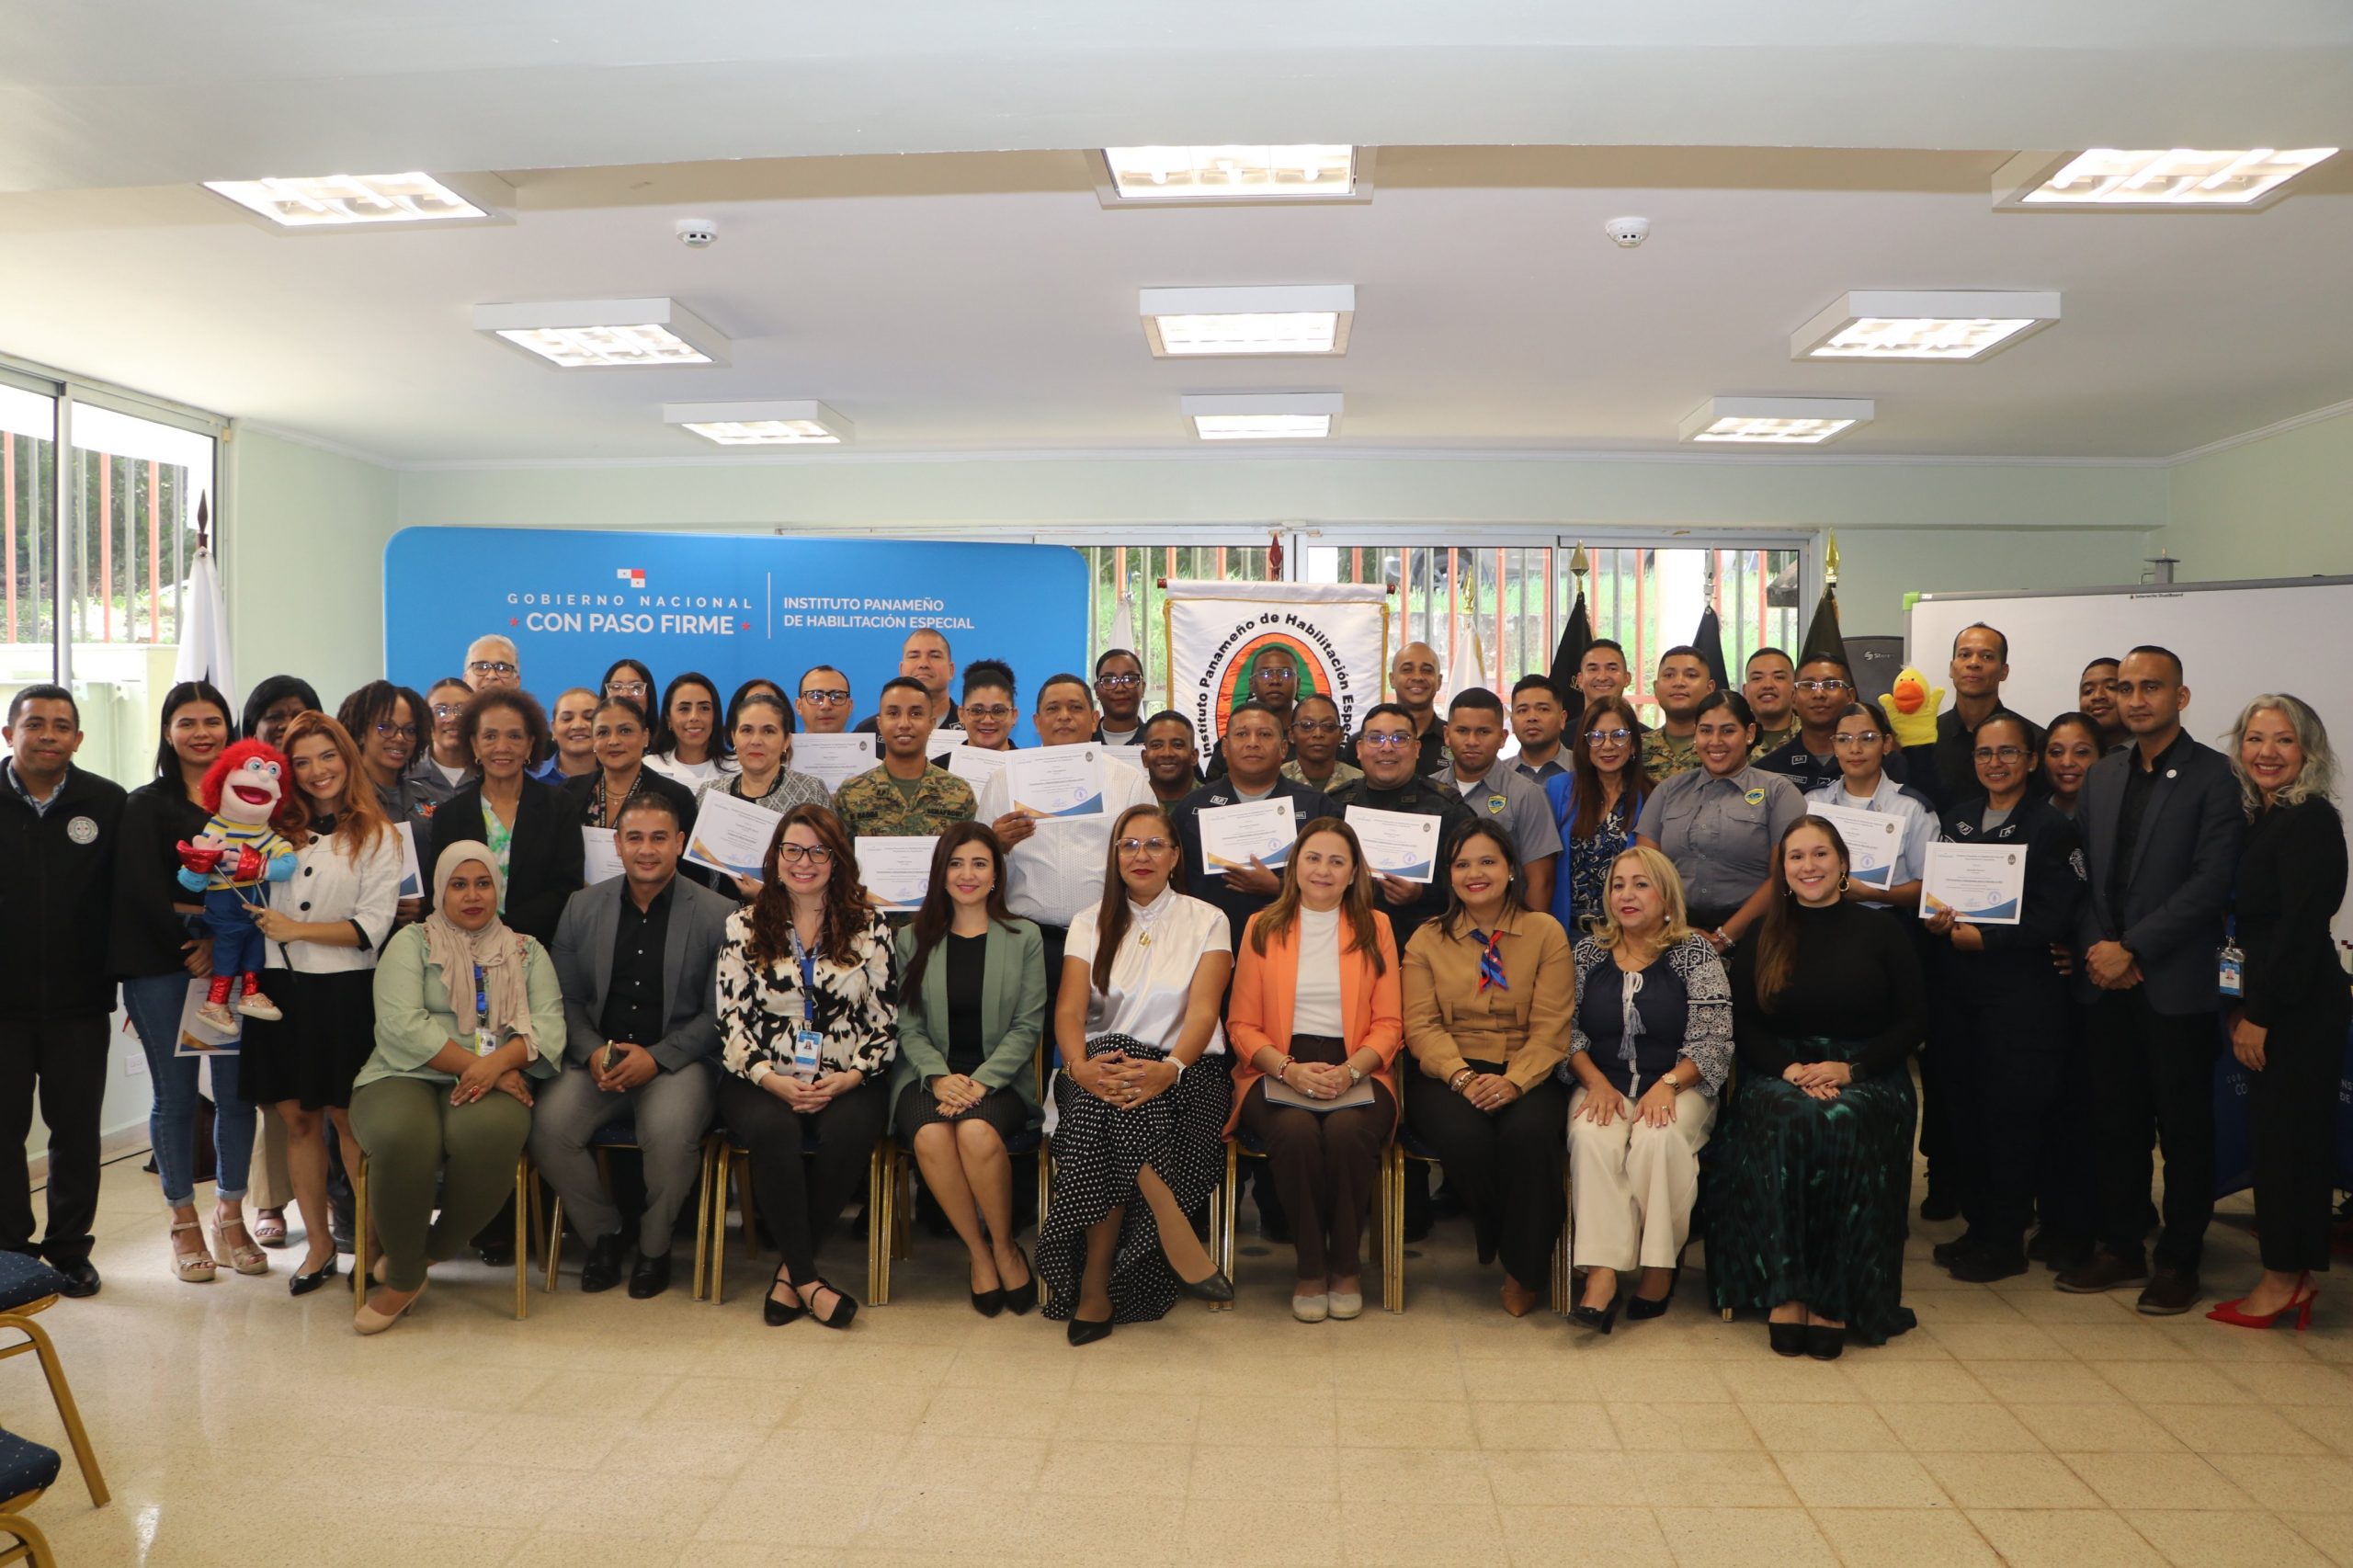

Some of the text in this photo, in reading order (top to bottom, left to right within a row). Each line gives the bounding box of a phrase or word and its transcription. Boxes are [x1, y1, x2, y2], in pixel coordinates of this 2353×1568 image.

[507, 593, 752, 608] GOBIERNO NACIONAL
[783, 597, 945, 612] INSTITUTO PANAMEÑO
[526, 612, 735, 635] CON PASO FIRME
[783, 613, 975, 629] DE HABILITACIÓN ESPECIAL
[1197, 612, 1354, 758] Instituto Panameño de Habilitación Espec
